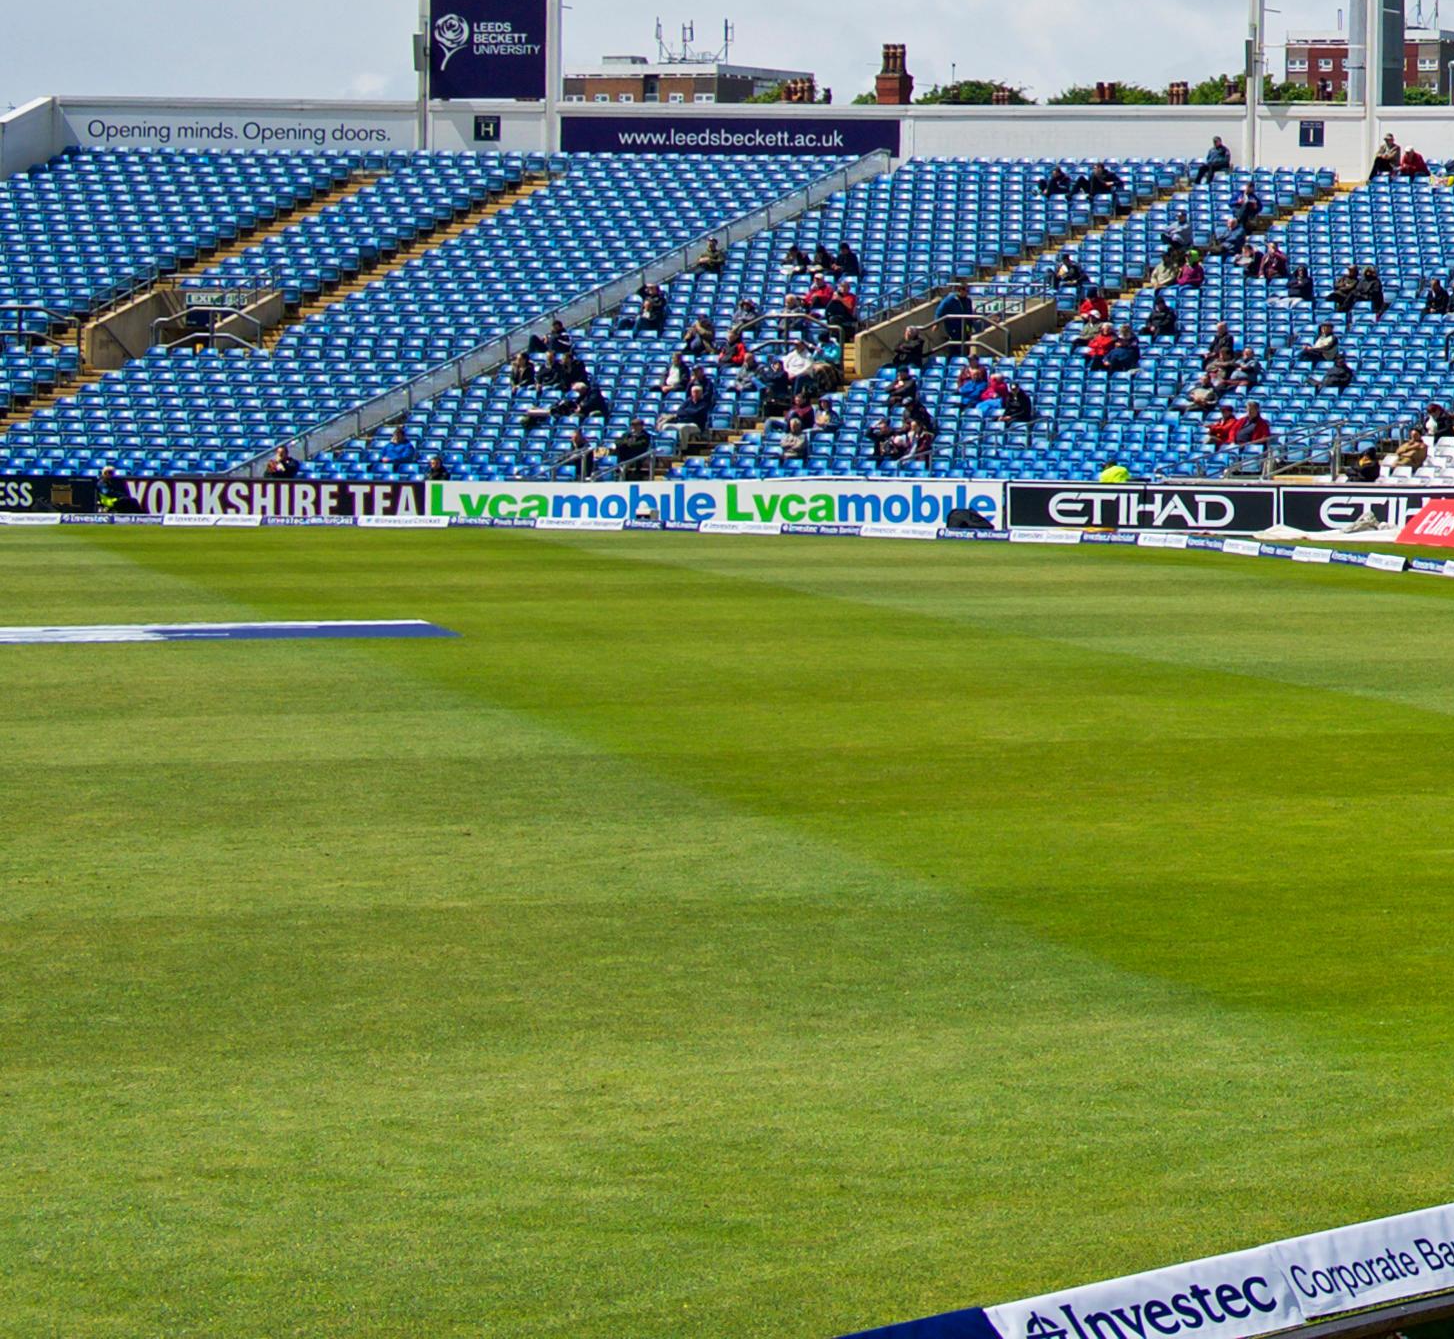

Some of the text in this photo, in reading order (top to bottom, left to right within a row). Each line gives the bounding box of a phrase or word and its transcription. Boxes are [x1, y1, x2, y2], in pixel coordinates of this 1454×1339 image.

[473, 23, 512, 33] LEEDS
[473, 33, 527, 44] BECKETT
[473, 44, 541, 55] UNIVERSITY
[87, 120, 392, 145] Opening minds. Opening doors.
[480, 123, 493, 138] H
[618, 129, 844, 148] www.leedsbeckett.ac.uk
[350, 484, 420, 516] TEA
[431, 484, 716, 520] Lycamobile
[727, 484, 997, 524] Lycamobile
[1048, 491, 1235, 527] ETIHAD
[1060, 1276, 1278, 1339] Investec
[1290, 1251, 1416, 1300] Corporate
